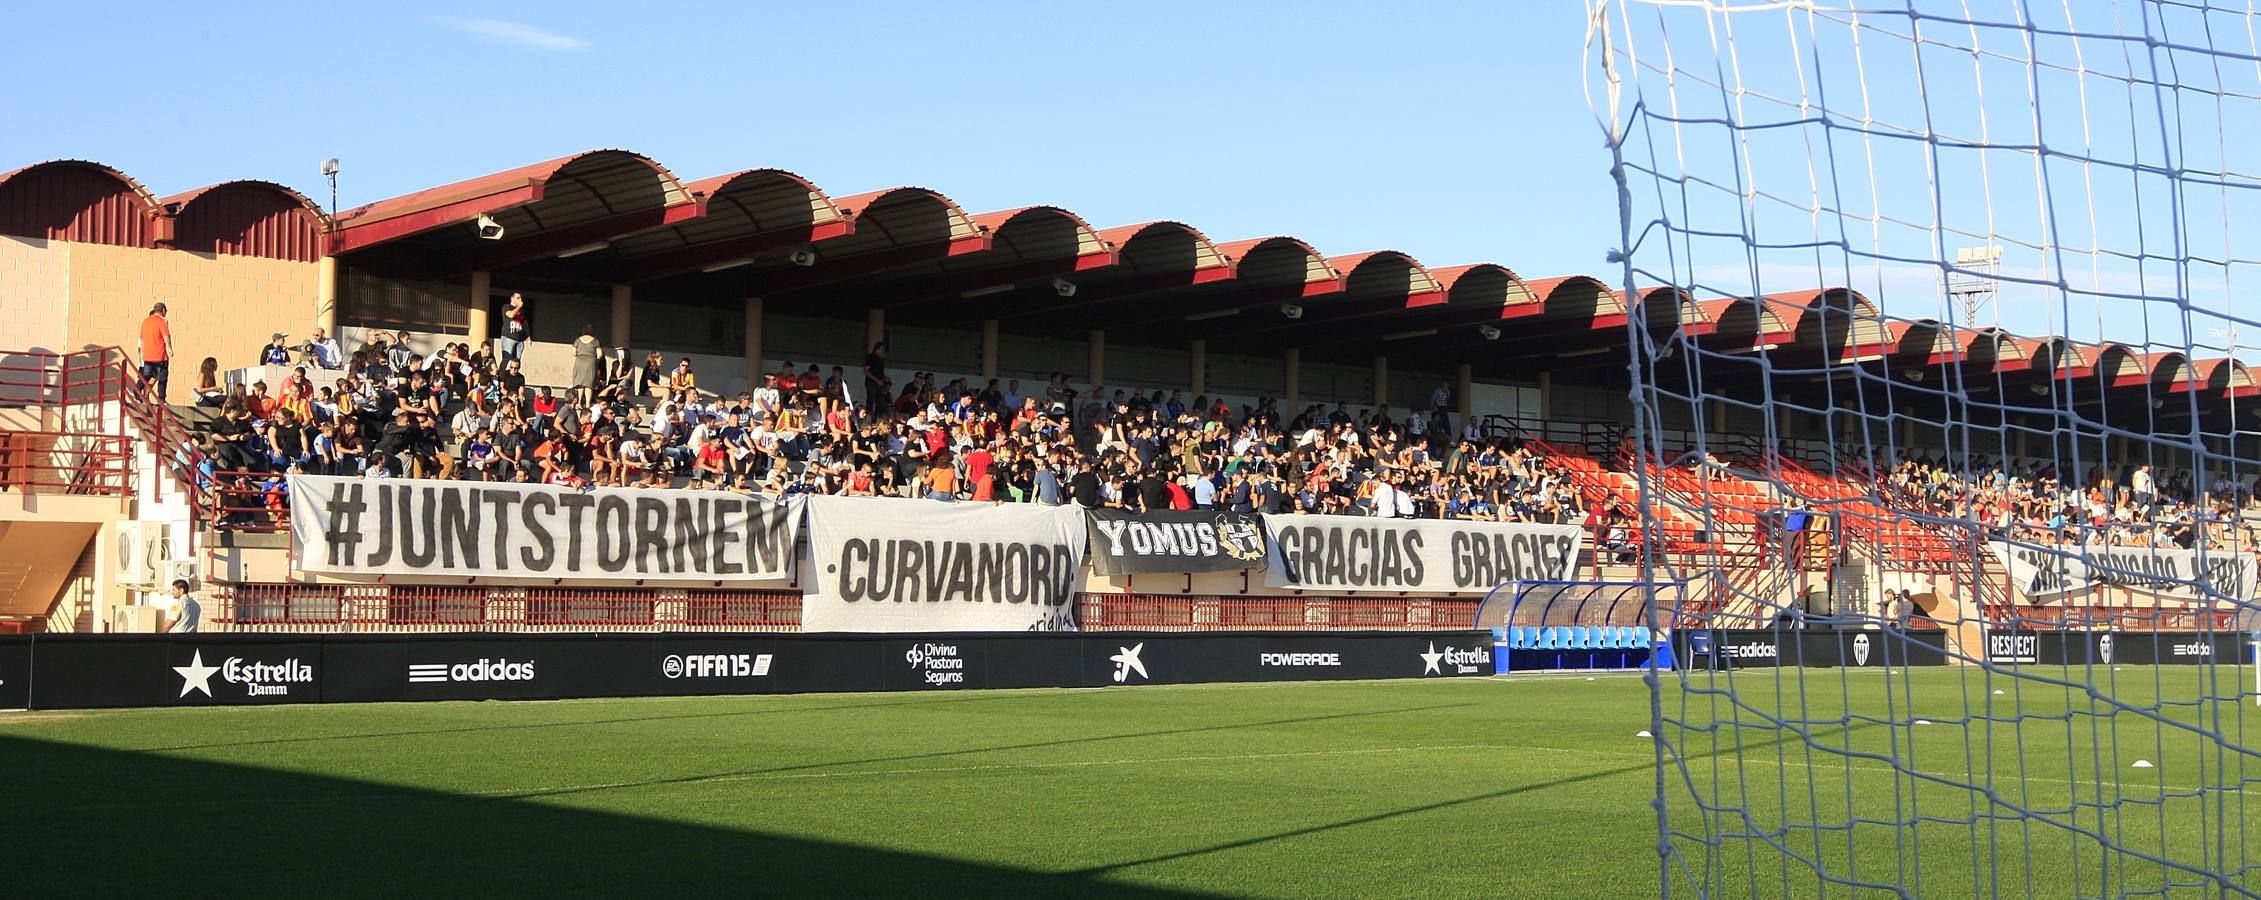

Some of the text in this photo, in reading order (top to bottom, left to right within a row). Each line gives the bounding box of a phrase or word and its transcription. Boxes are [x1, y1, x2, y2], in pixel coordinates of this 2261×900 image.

[325, 482, 791, 574] #JUNTSTORNEM
[1097, 520, 1218, 557] YOMUS
[1279, 525, 1424, 587] GRACIAS
[925, 643, 957, 656] Divina
[1444, 645, 1490, 665] Estrella
[1739, 641, 1777, 657] adidas
[925, 656, 963, 669] Pastora
[1261, 653, 1341, 666] POWERADE
[222, 656, 313, 683] Estrella
[451, 658, 535, 681] adidas
[925, 671, 963, 686] Seguros
[248, 683, 288, 696] Damm
